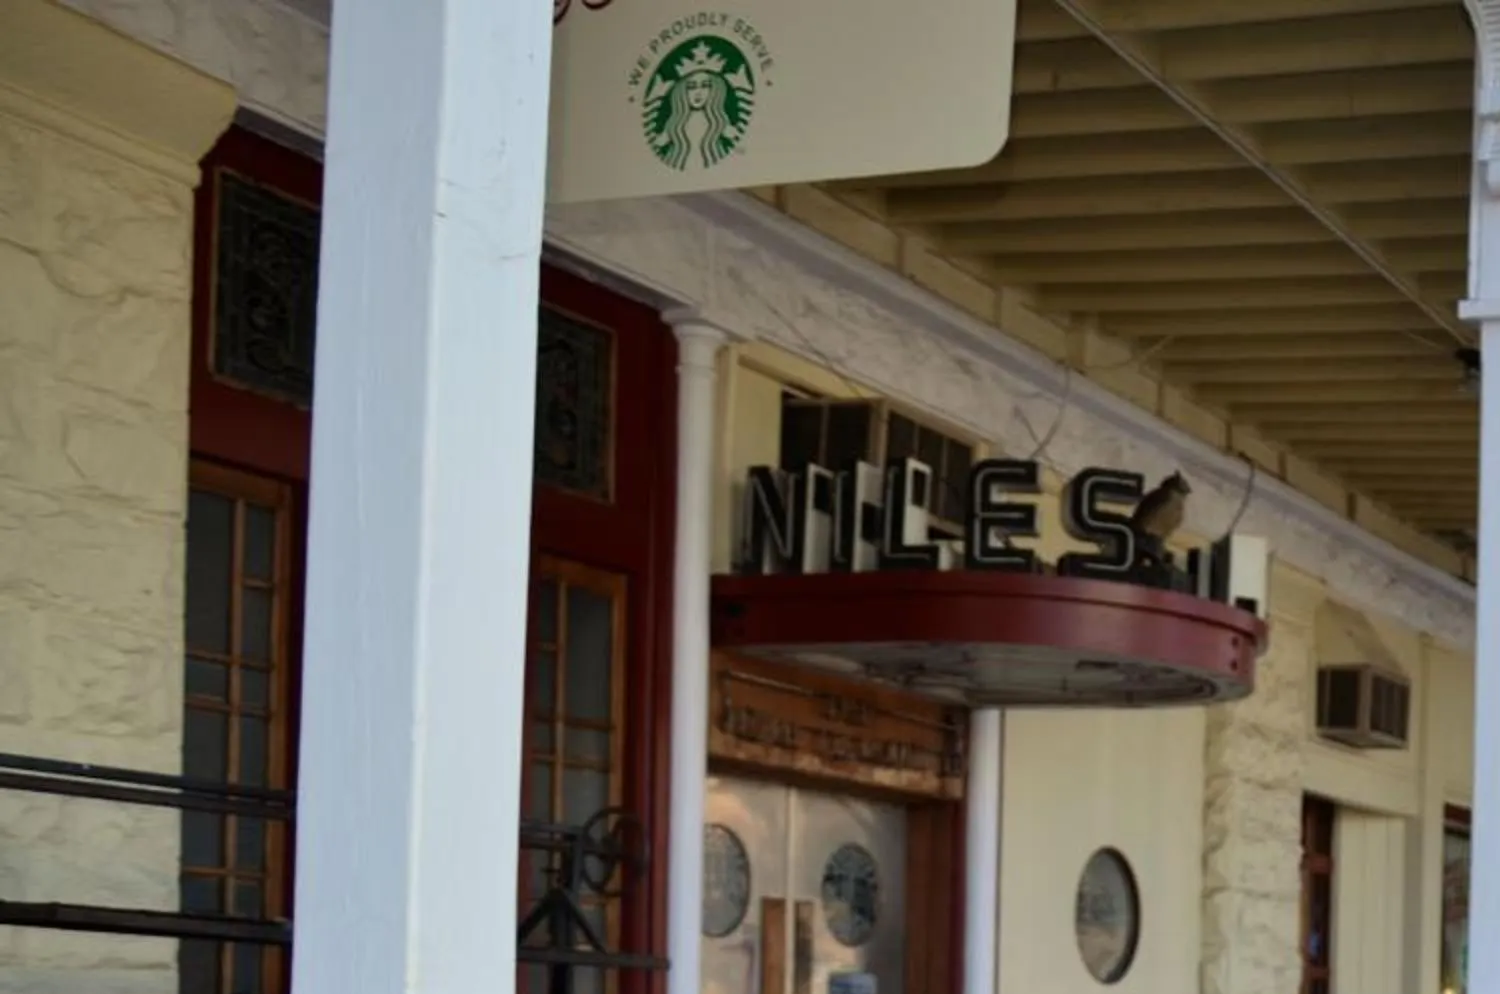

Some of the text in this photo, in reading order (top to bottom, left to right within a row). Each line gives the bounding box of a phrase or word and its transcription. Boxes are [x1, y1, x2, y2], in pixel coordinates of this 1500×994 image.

[628, 55, 650, 86] WE
[649, 11, 728, 53] PROUDLY
[733, 18, 774, 72] SERVE
[733, 457, 1146, 579] NILES
